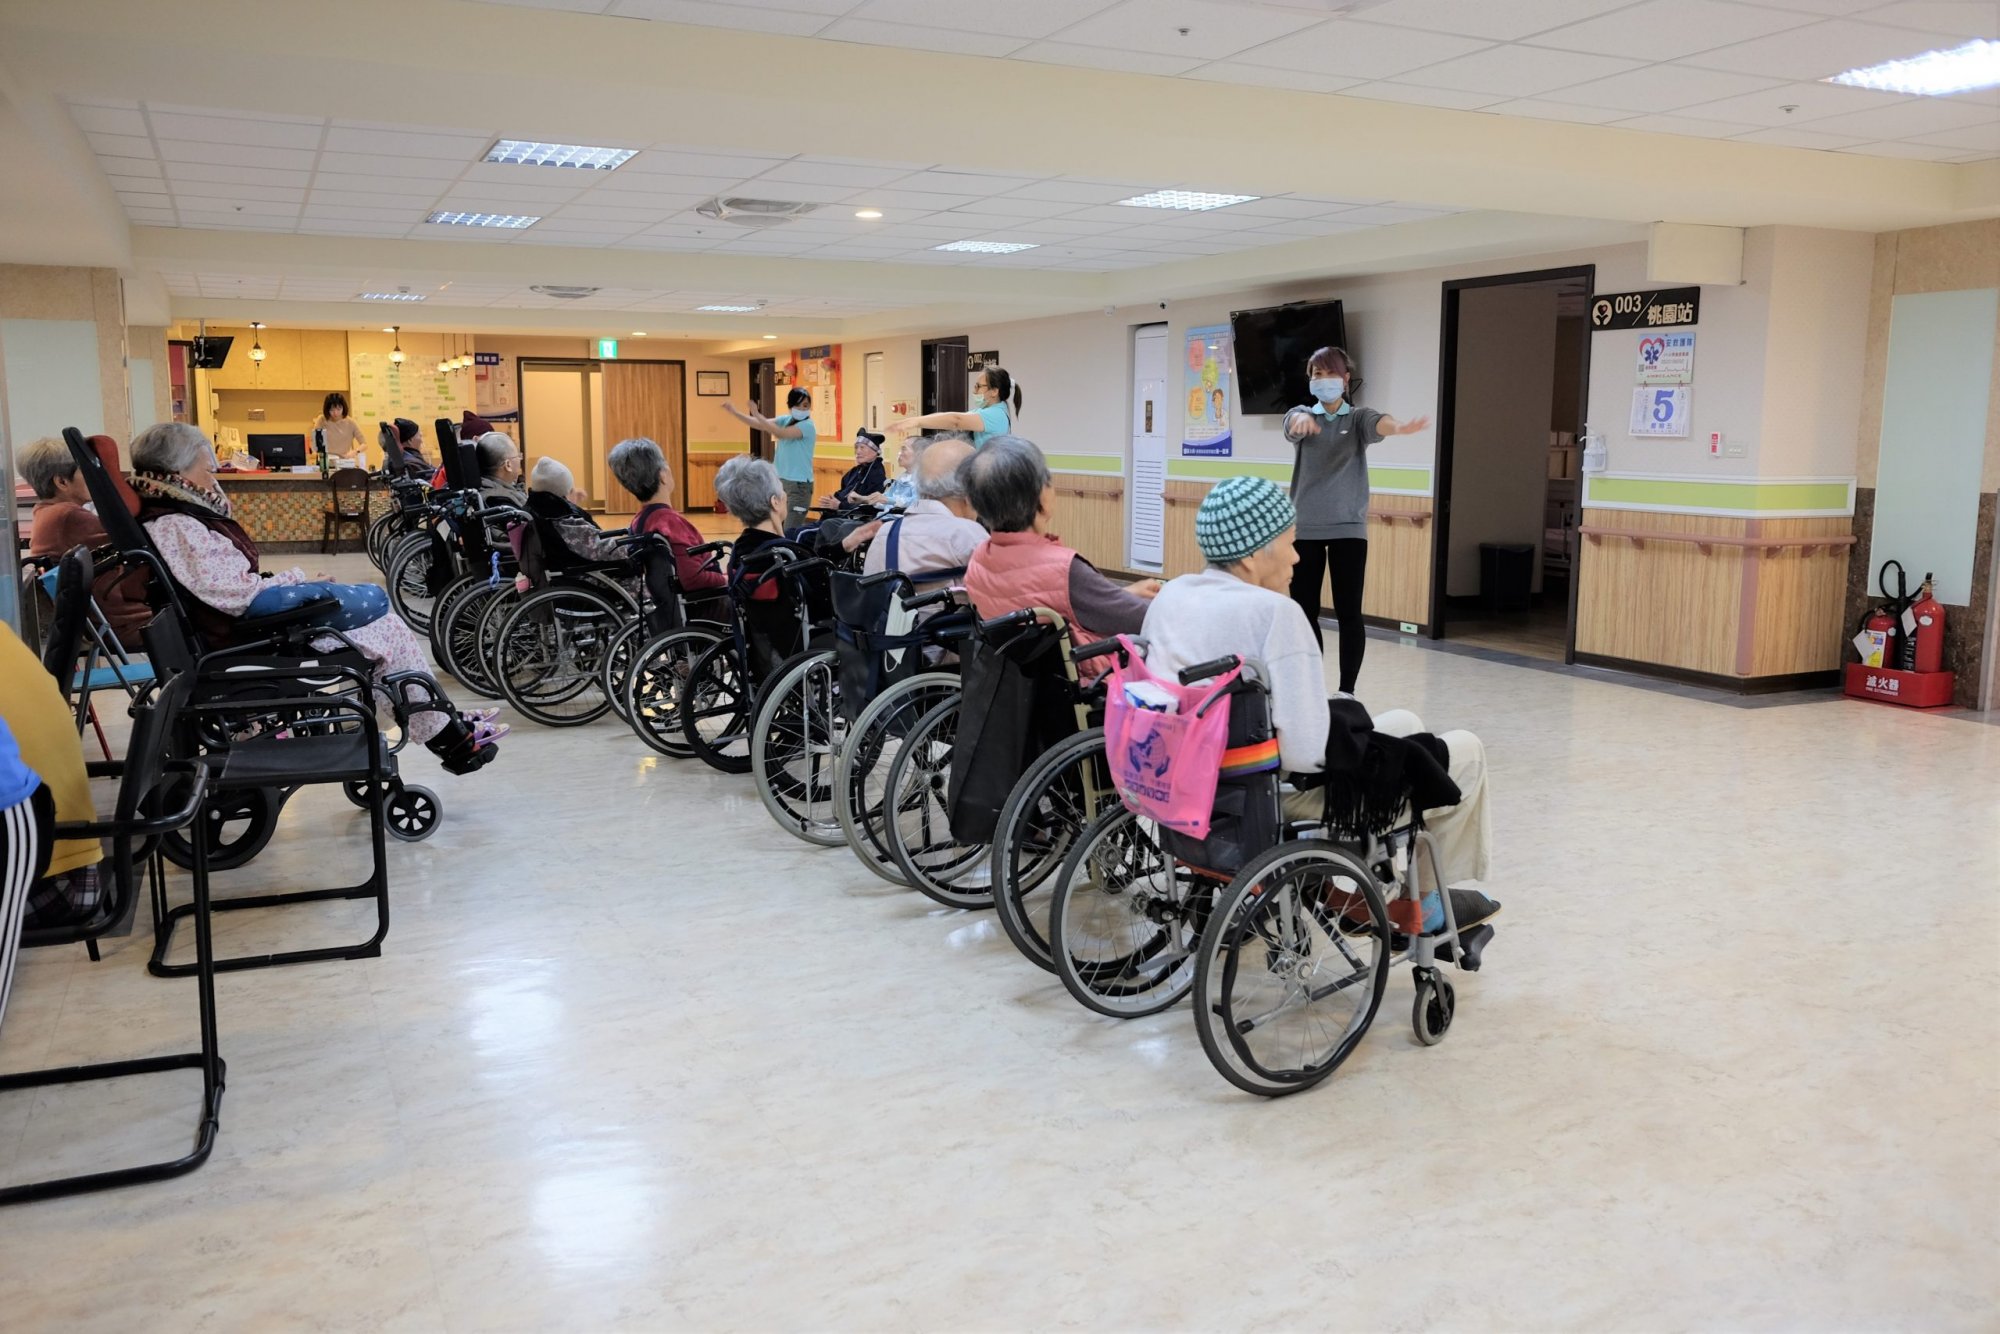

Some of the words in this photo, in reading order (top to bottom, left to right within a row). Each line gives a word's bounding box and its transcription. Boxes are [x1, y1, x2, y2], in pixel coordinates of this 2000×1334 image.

[1615, 294, 1642, 314] 003
[1646, 302, 1694, 325] 桃園站
[1653, 389, 1675, 422] 5
